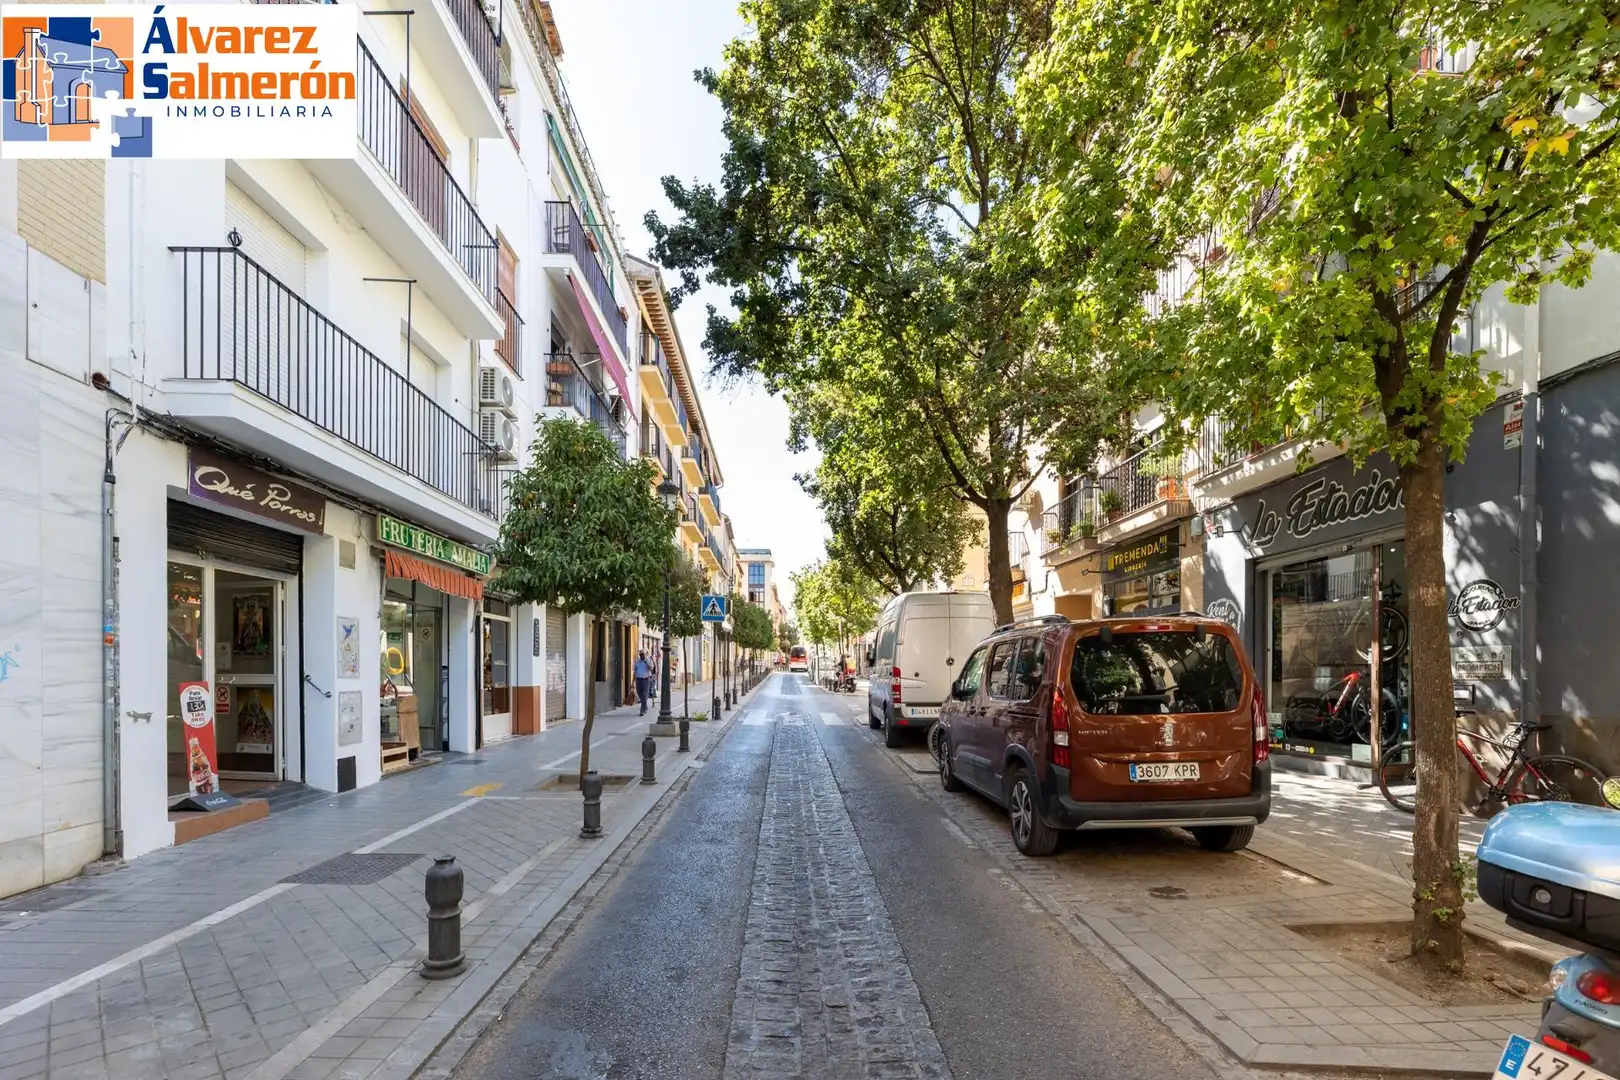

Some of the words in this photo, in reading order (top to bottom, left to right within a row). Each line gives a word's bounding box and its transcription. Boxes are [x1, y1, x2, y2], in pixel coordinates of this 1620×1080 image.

[194, 465, 255, 500] Qué
[1248, 499, 1282, 548] La
[382, 517, 444, 558] FRUTERIA
[451, 545, 487, 573] AMALIA
[1207, 600, 1229, 618] Rent
[1137, 764, 1169, 778] 3607
[1173, 763, 1198, 777] KPR
